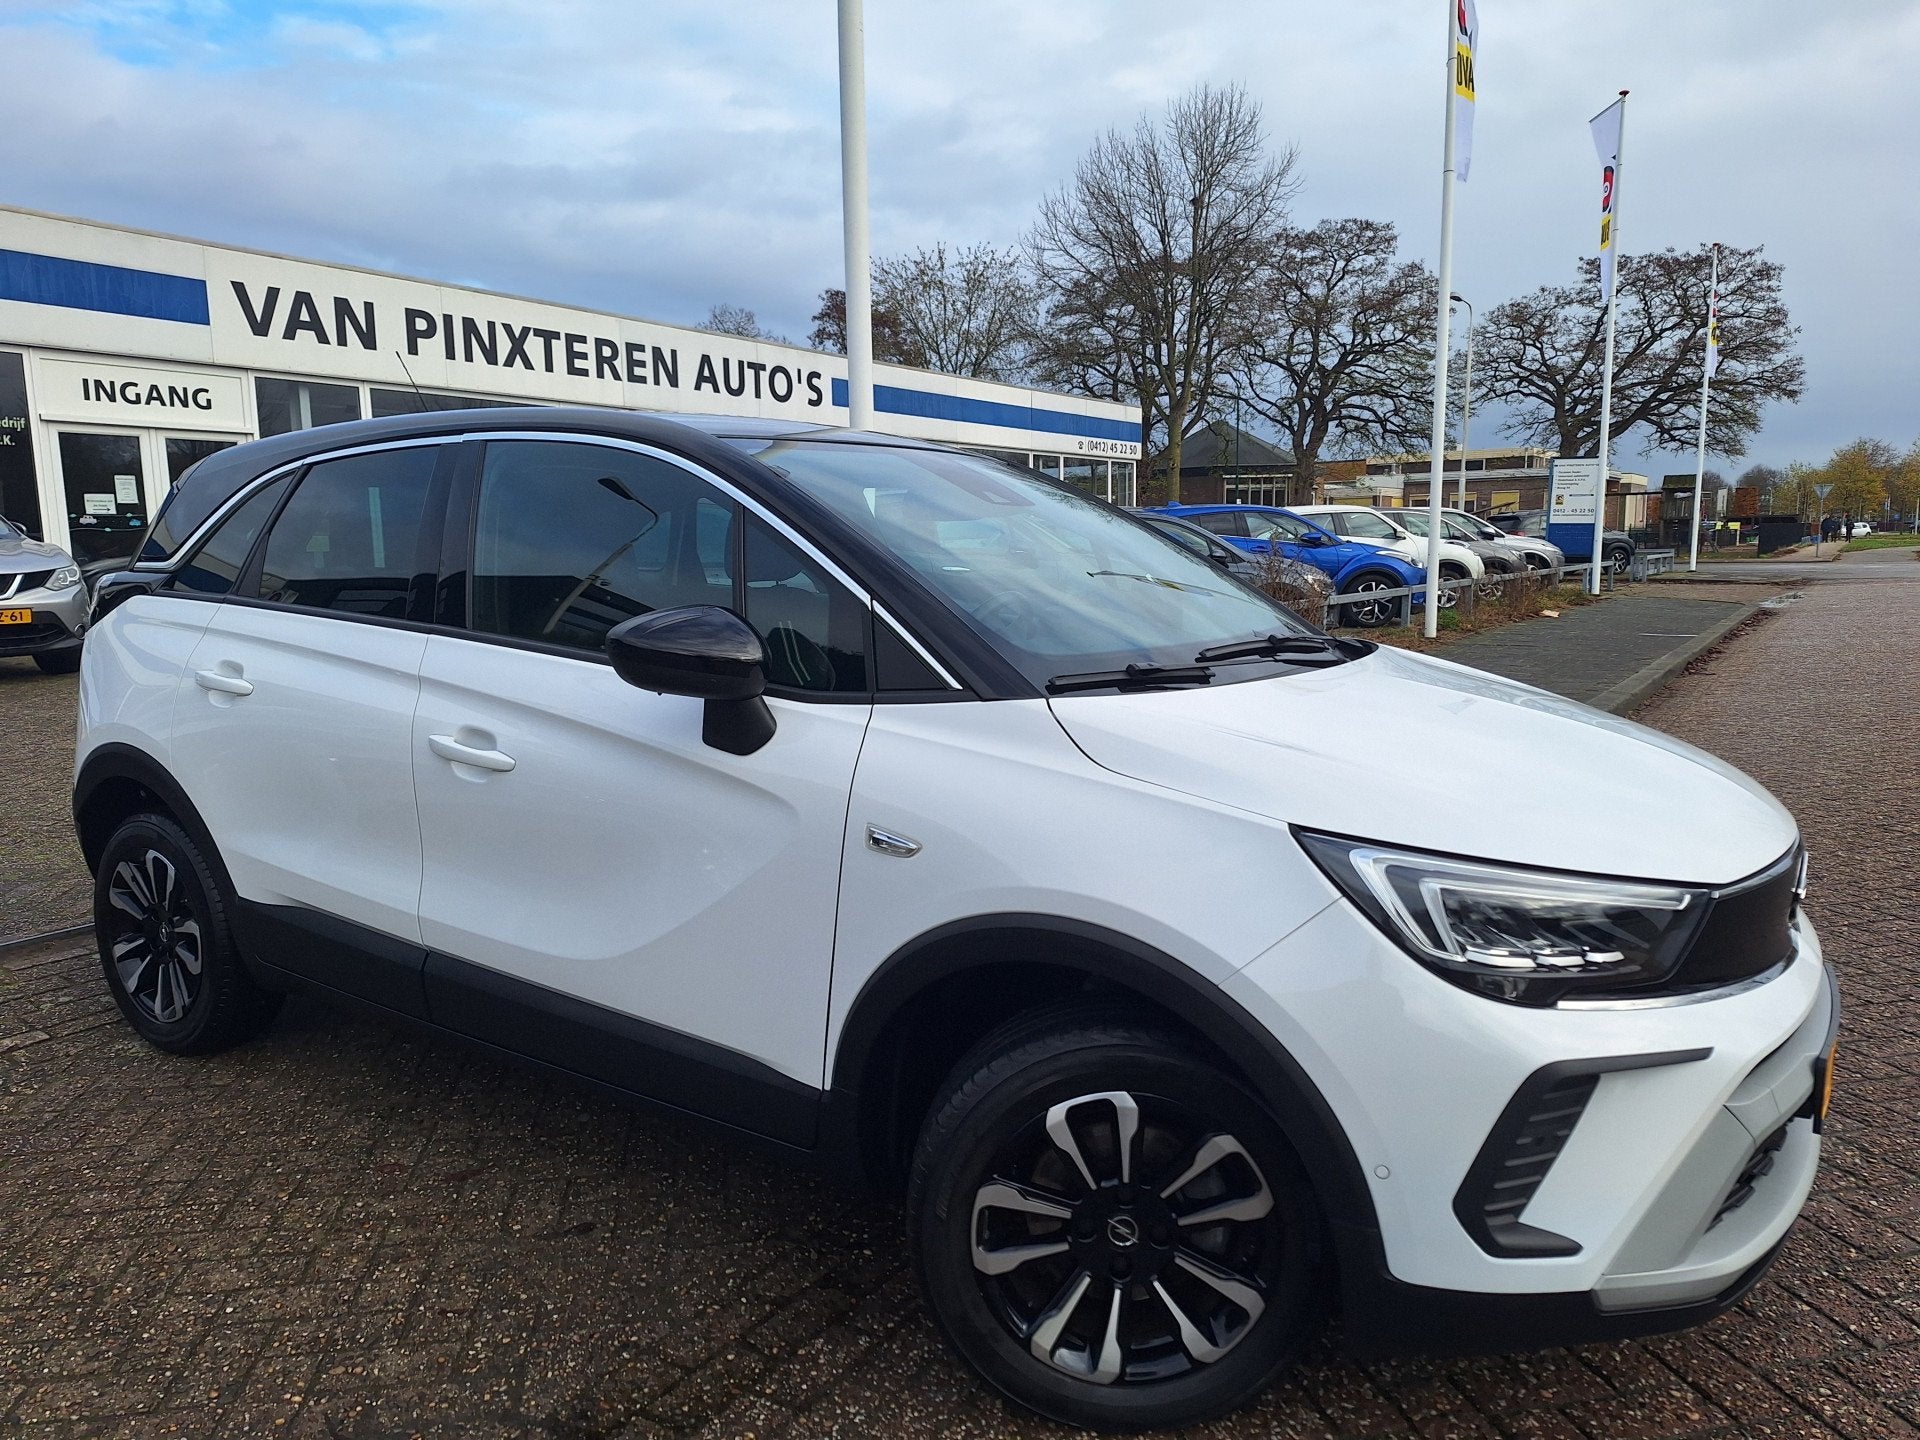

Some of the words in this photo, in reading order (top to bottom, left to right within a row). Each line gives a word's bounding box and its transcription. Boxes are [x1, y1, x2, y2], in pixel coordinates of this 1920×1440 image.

[230, 281, 378, 350] VAN
[405, 308, 679, 388] PINXTEREN
[694, 354, 823, 407] AUTO'S
[82, 378, 212, 410] INGANG
[0, 416, 25, 431] drijf
[1087, 440, 1108, 454] (0412)
[1110, 443, 1118, 453] 45
[1119, 444, 1128, 454] 22
[1129, 445, 1138, 455] 50
